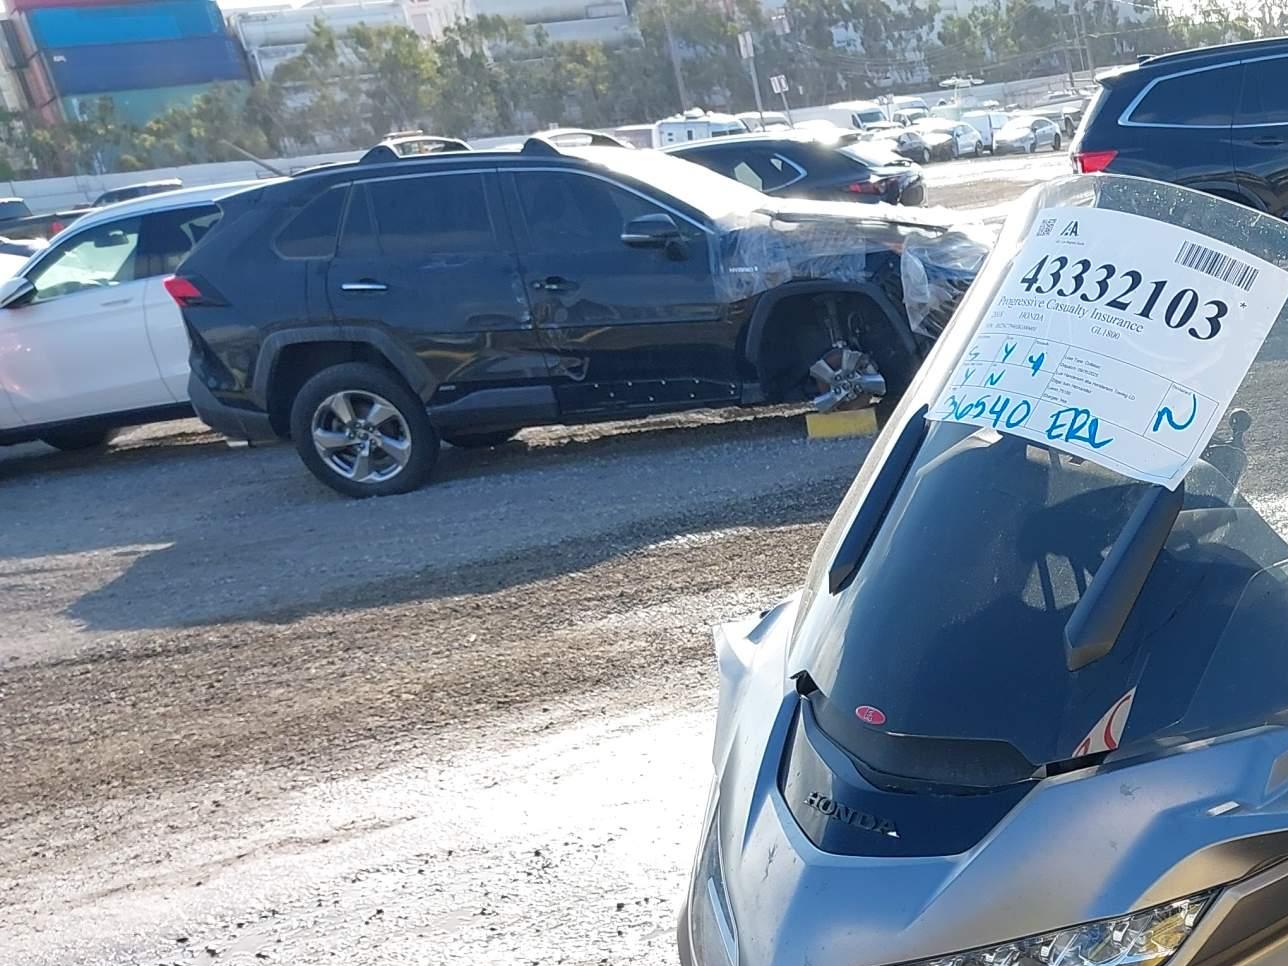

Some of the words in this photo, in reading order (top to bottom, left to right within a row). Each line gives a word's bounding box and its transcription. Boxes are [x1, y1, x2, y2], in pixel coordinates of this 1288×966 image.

[998, 295, 1045, 310] Progressive
[1046, 298, 1088, 319] Casualty
[1090, 307, 1144, 333] Insurance
[1018, 311, 1045, 322] HONDA
[1019, 254, 1229, 341] 43332103
[942, 394, 1031, 429] 36540
[803, 791, 900, 838] HONDA
